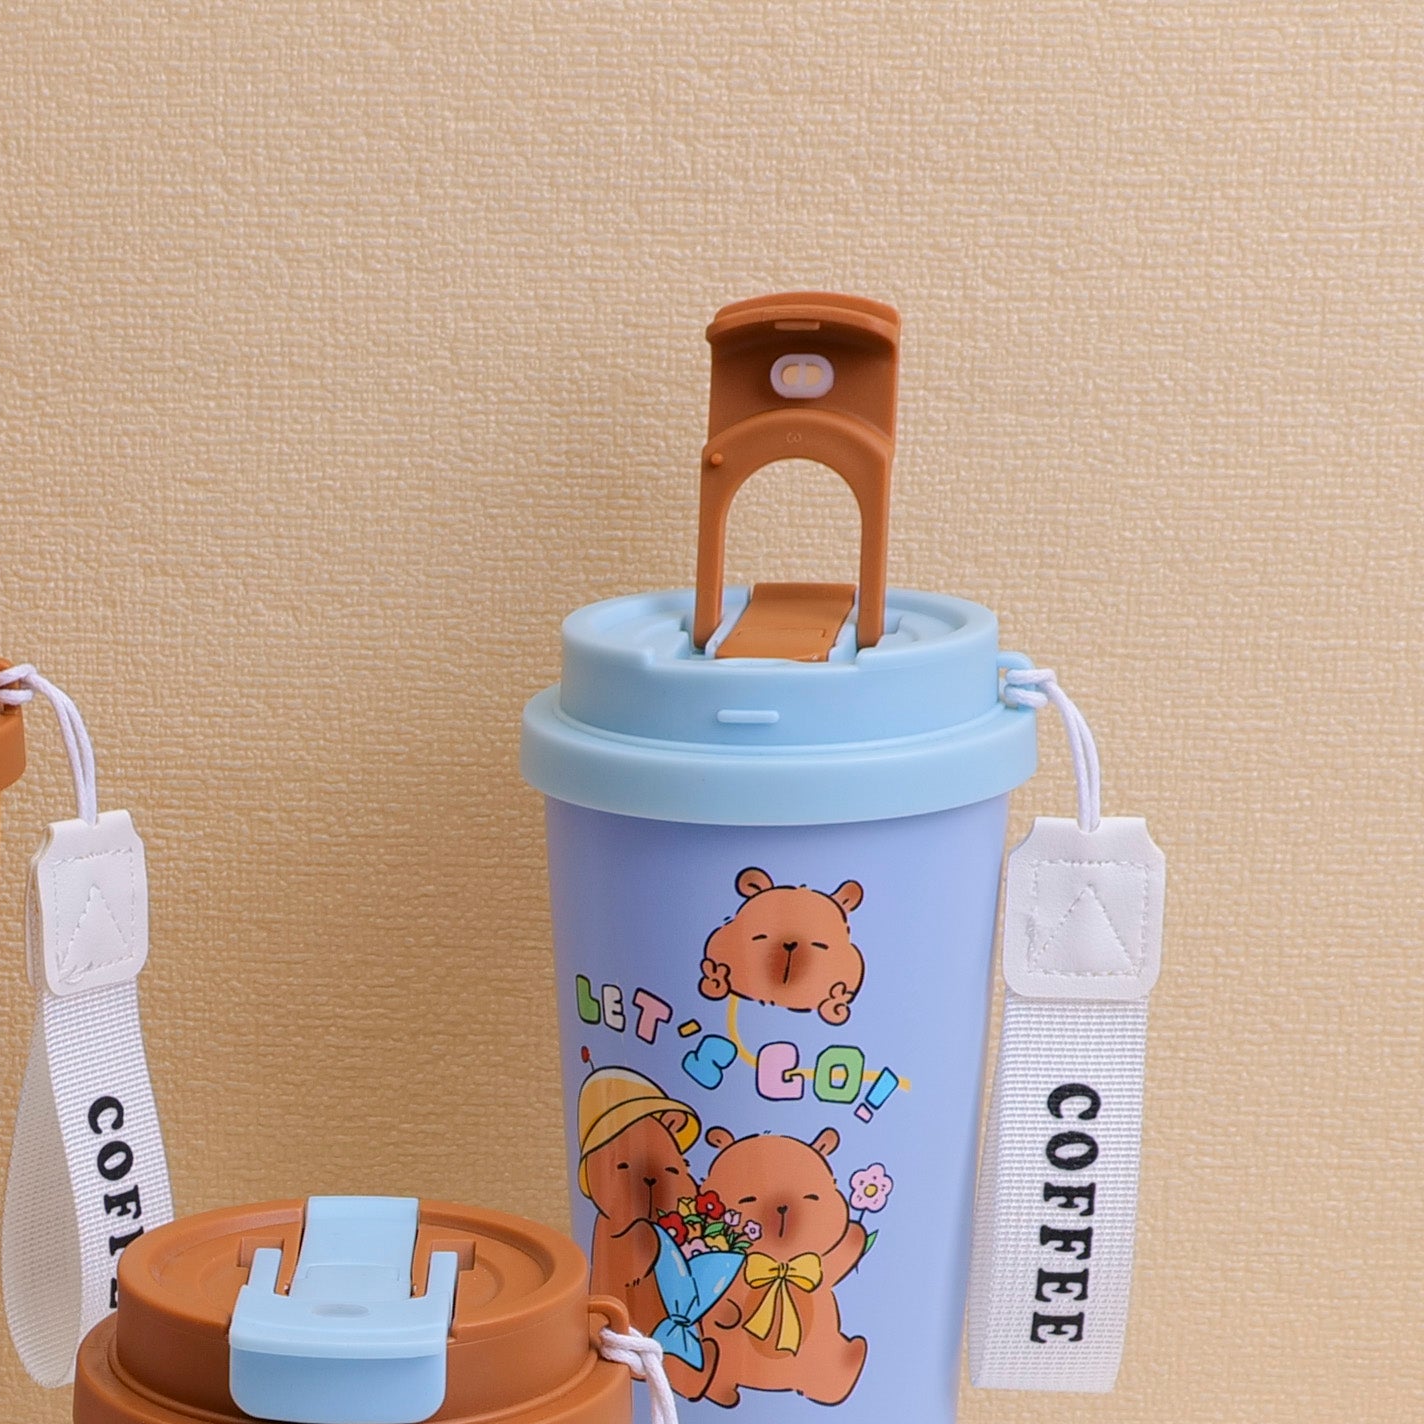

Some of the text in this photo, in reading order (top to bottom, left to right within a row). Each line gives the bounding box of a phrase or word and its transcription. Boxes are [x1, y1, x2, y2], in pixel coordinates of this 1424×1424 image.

[575, 974, 900, 1123] LET'S GO!
[1030, 1083, 1102, 1344] COFFEE
